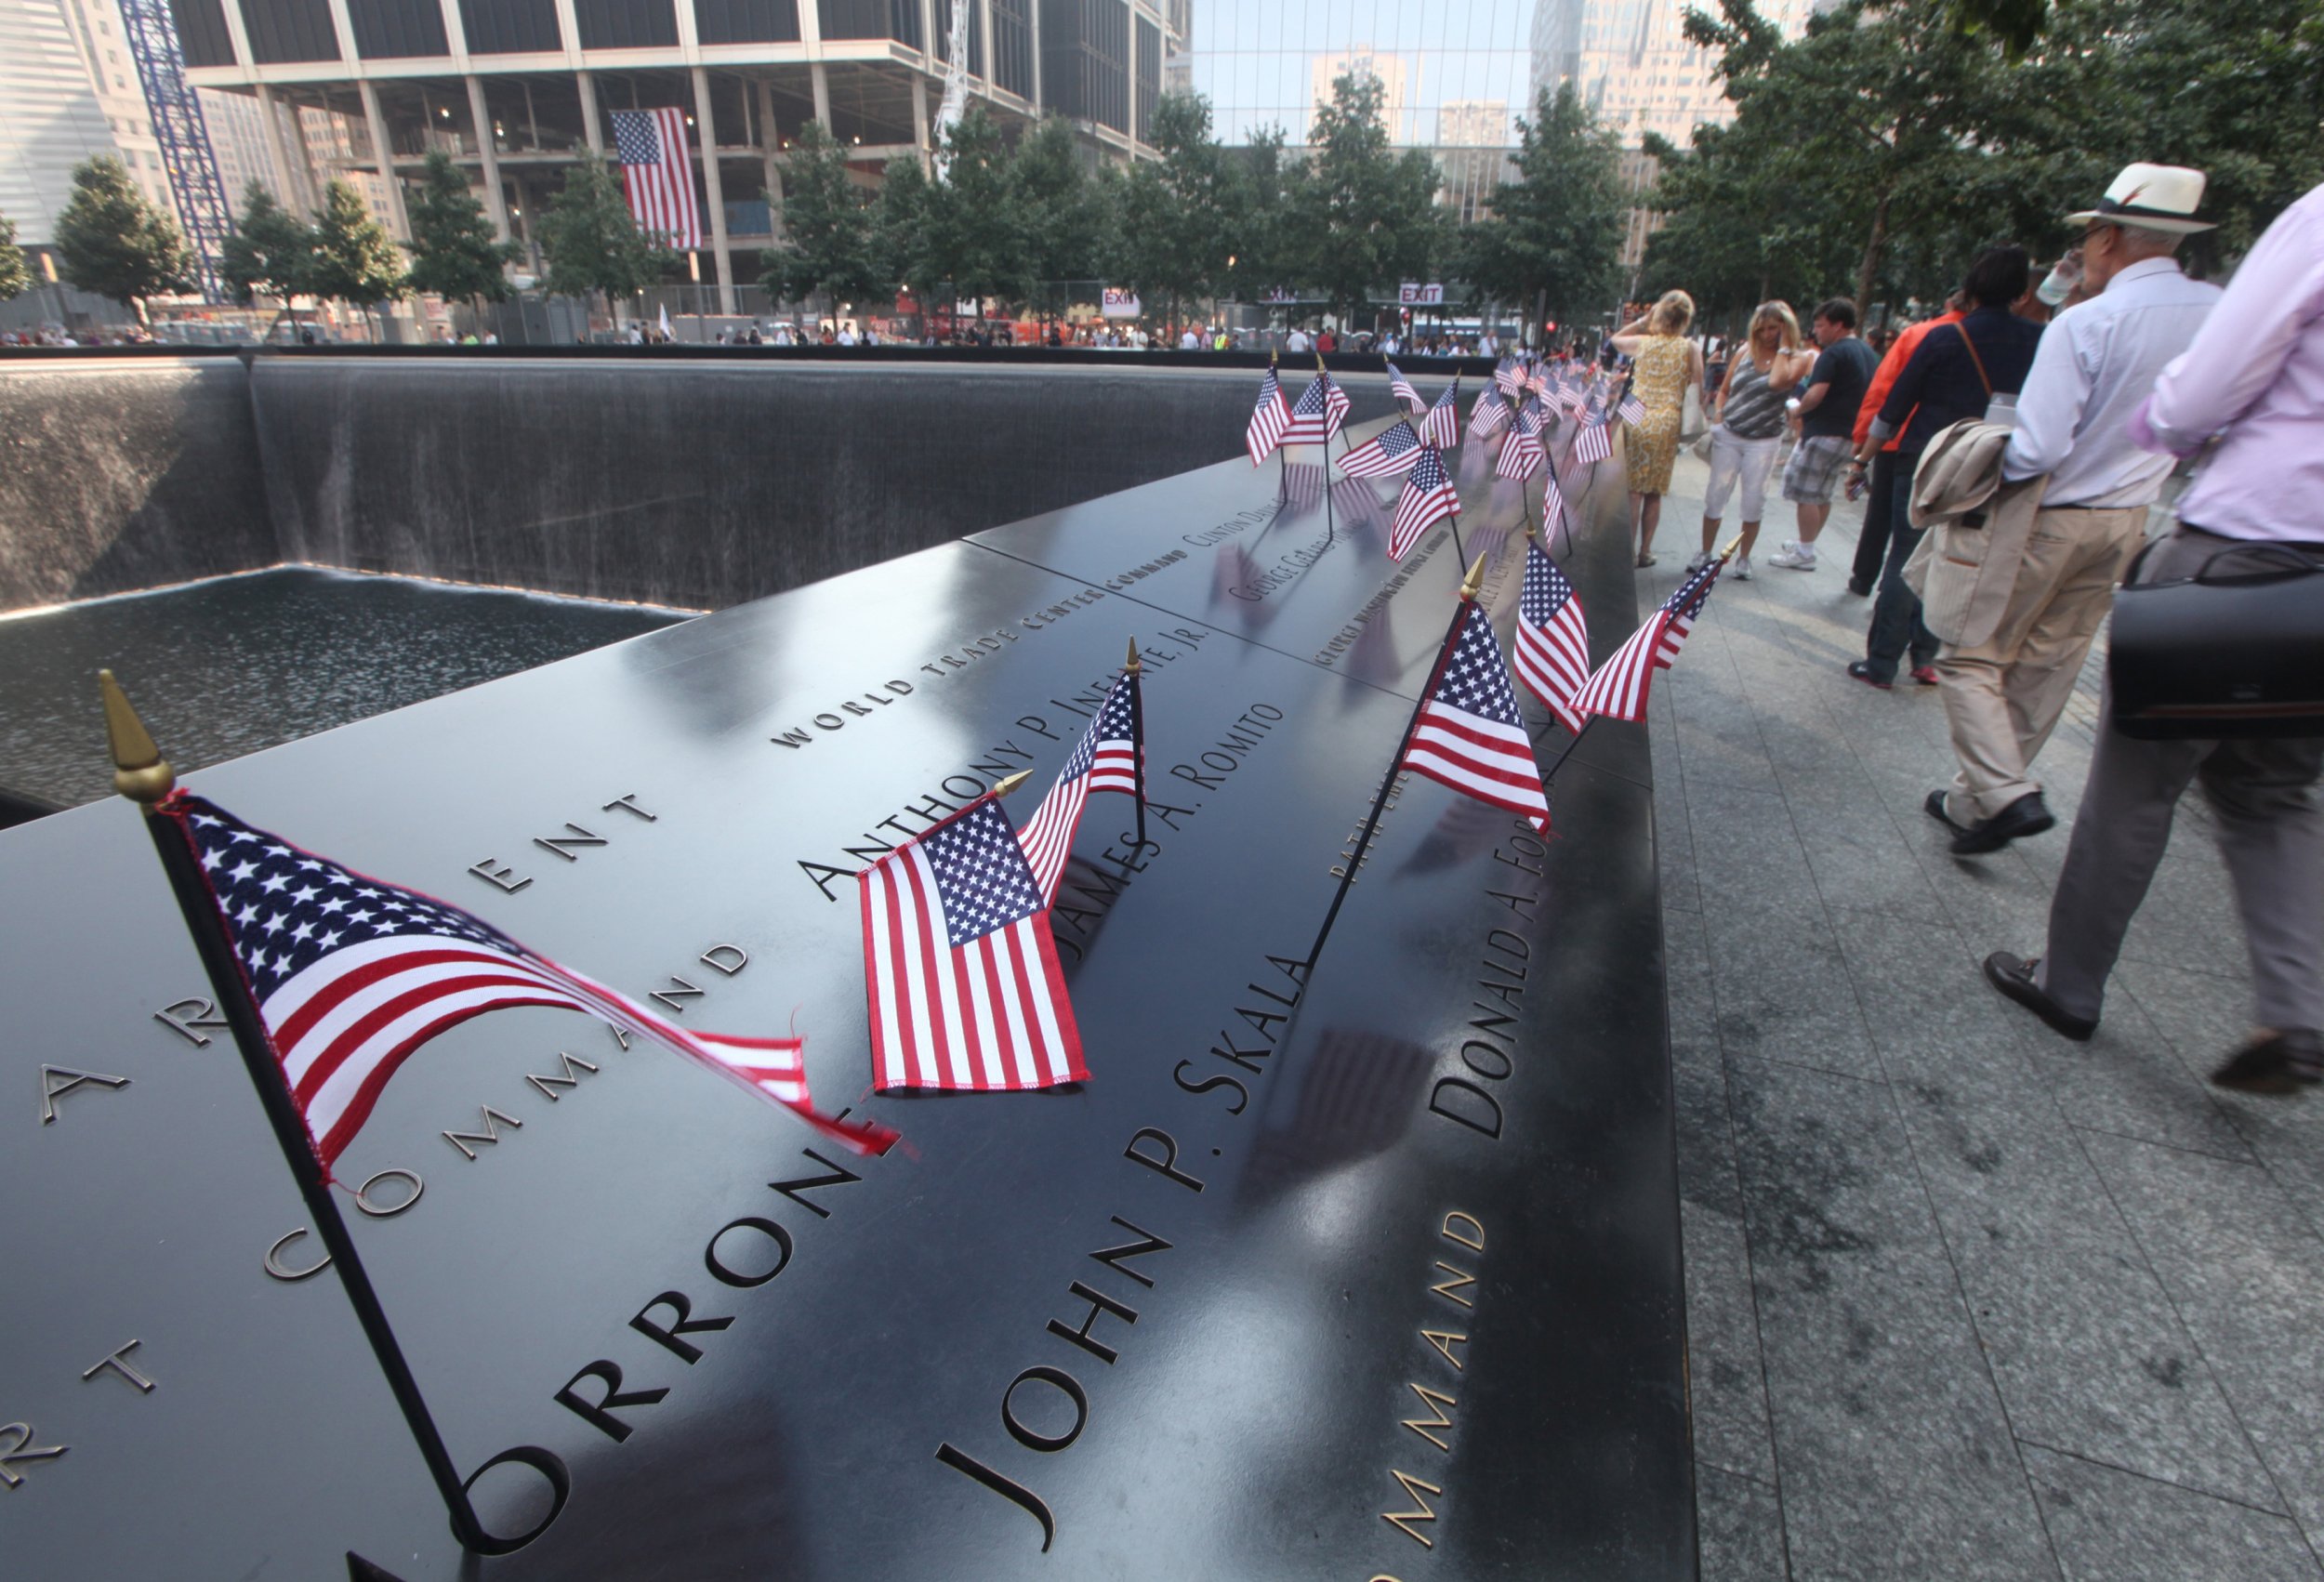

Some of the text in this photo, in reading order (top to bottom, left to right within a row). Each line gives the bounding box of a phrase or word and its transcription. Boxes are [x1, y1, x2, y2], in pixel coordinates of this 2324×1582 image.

[1402, 287, 1439, 302] EXIT
[1182, 518, 1251, 547] CLINTON
[1229, 565, 1299, 602] GEORGE
[1313, 624, 1361, 666] GEORGE
[1353, 573, 1409, 623] WASHINGTON
[771, 548, 1188, 749] WORLD TRADE CENTER COMMAND
[798, 740, 1034, 903] ANTHONY
[1016, 715, 1074, 741] P.
[1157, 627, 1210, 652] JR.
[1052, 703, 1284, 961] JAMES A. ROMITO
[35, 792, 657, 1126] ARENT
[1429, 929, 1531, 1140] DONALD
[935, 954, 1312, 1554] JOHN P. SKALA
[1368, 1210, 1486, 1582] MMAND
